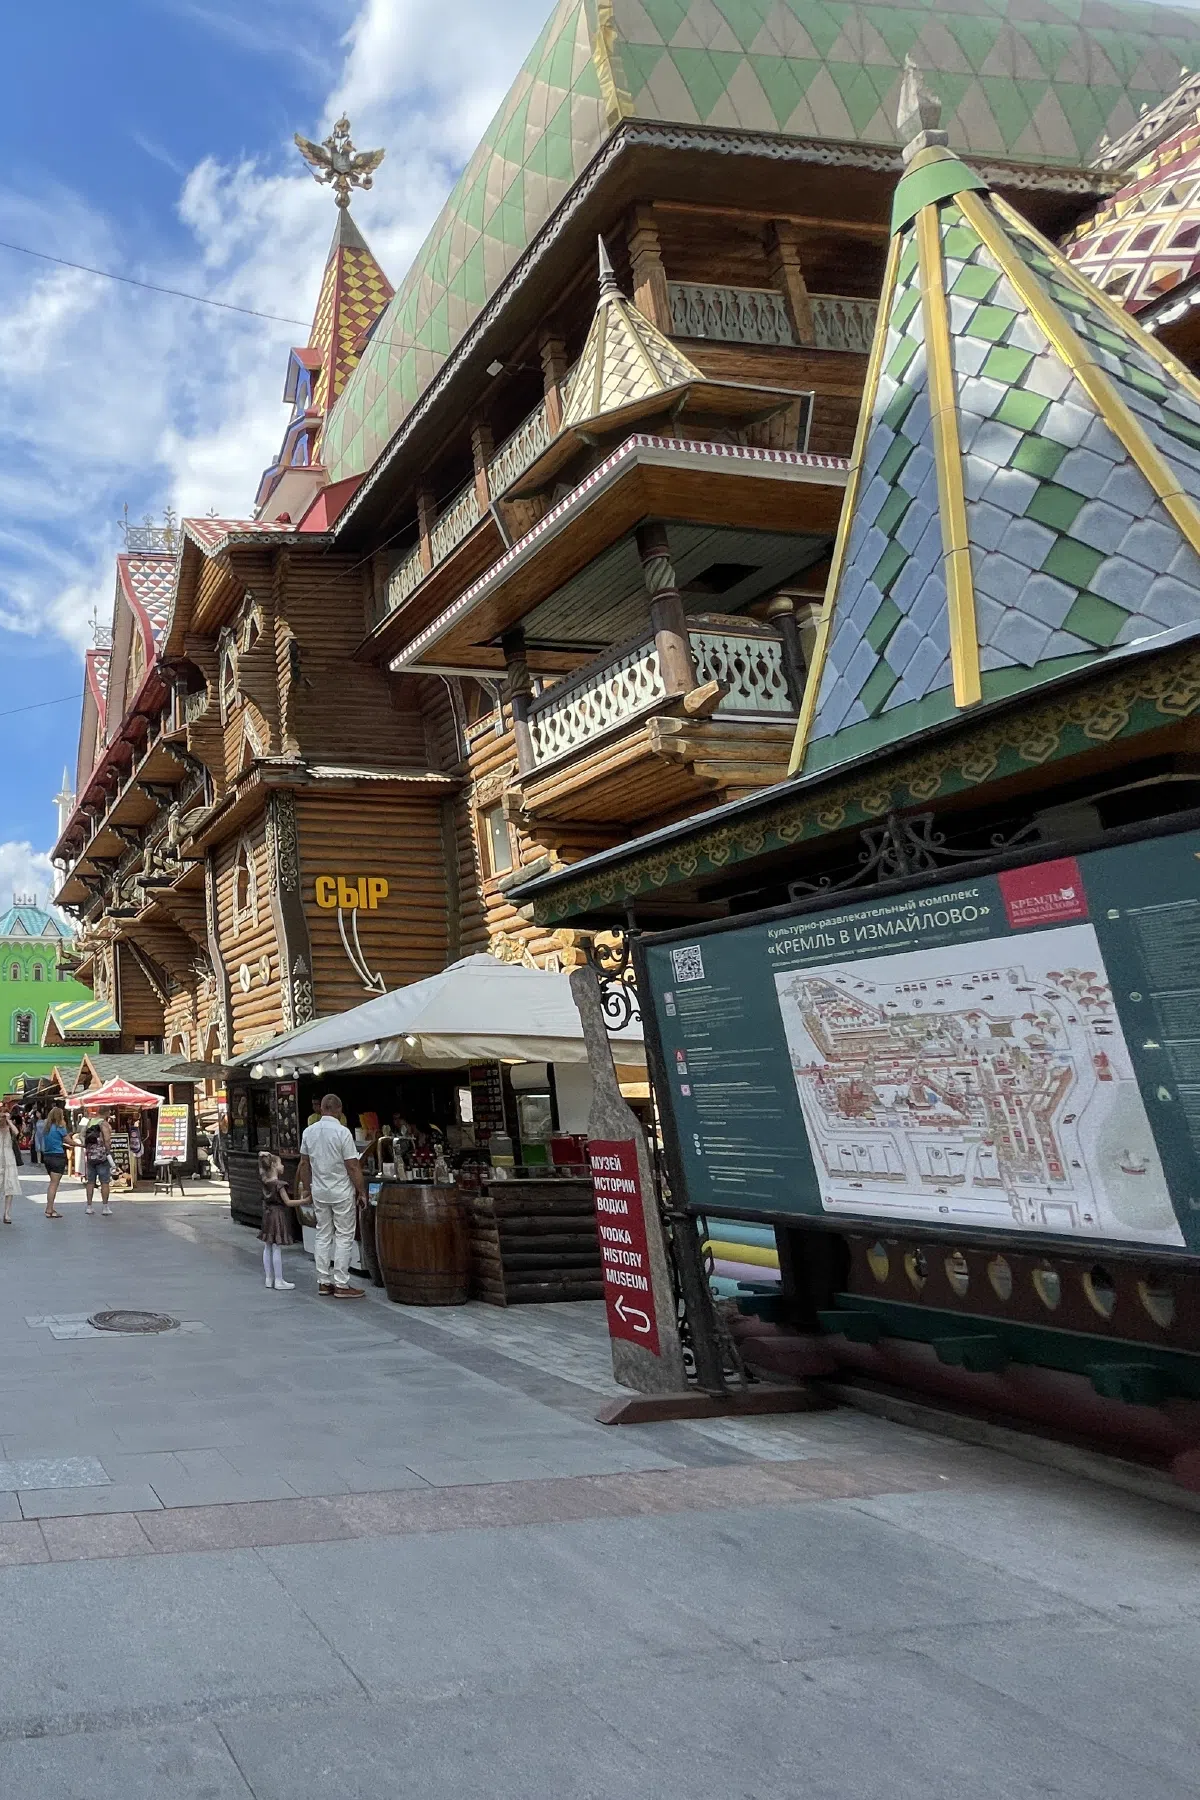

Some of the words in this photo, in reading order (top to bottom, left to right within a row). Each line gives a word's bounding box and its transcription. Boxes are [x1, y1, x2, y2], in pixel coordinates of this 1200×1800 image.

[315, 876, 389, 910] СЫР
[767, 900, 916, 938] Культурно-развлекательный
[918, 887, 979, 908] комплекс
[767, 932, 836, 956] «КРЕМЛЬ
[839, 929, 851, 944] В
[854, 904, 991, 941] ИЗМАЙЛОВО»
[590, 1153, 622, 1172] МУЗЕЙ
[593, 1176, 636, 1194] ИСТОРИИ
[596, 1196, 629, 1215] ВОДКИ
[600, 1225, 632, 1245] VODKA
[603, 1246, 642, 1268] HISTORY
[606, 1268, 649, 1292] MUSEUM
